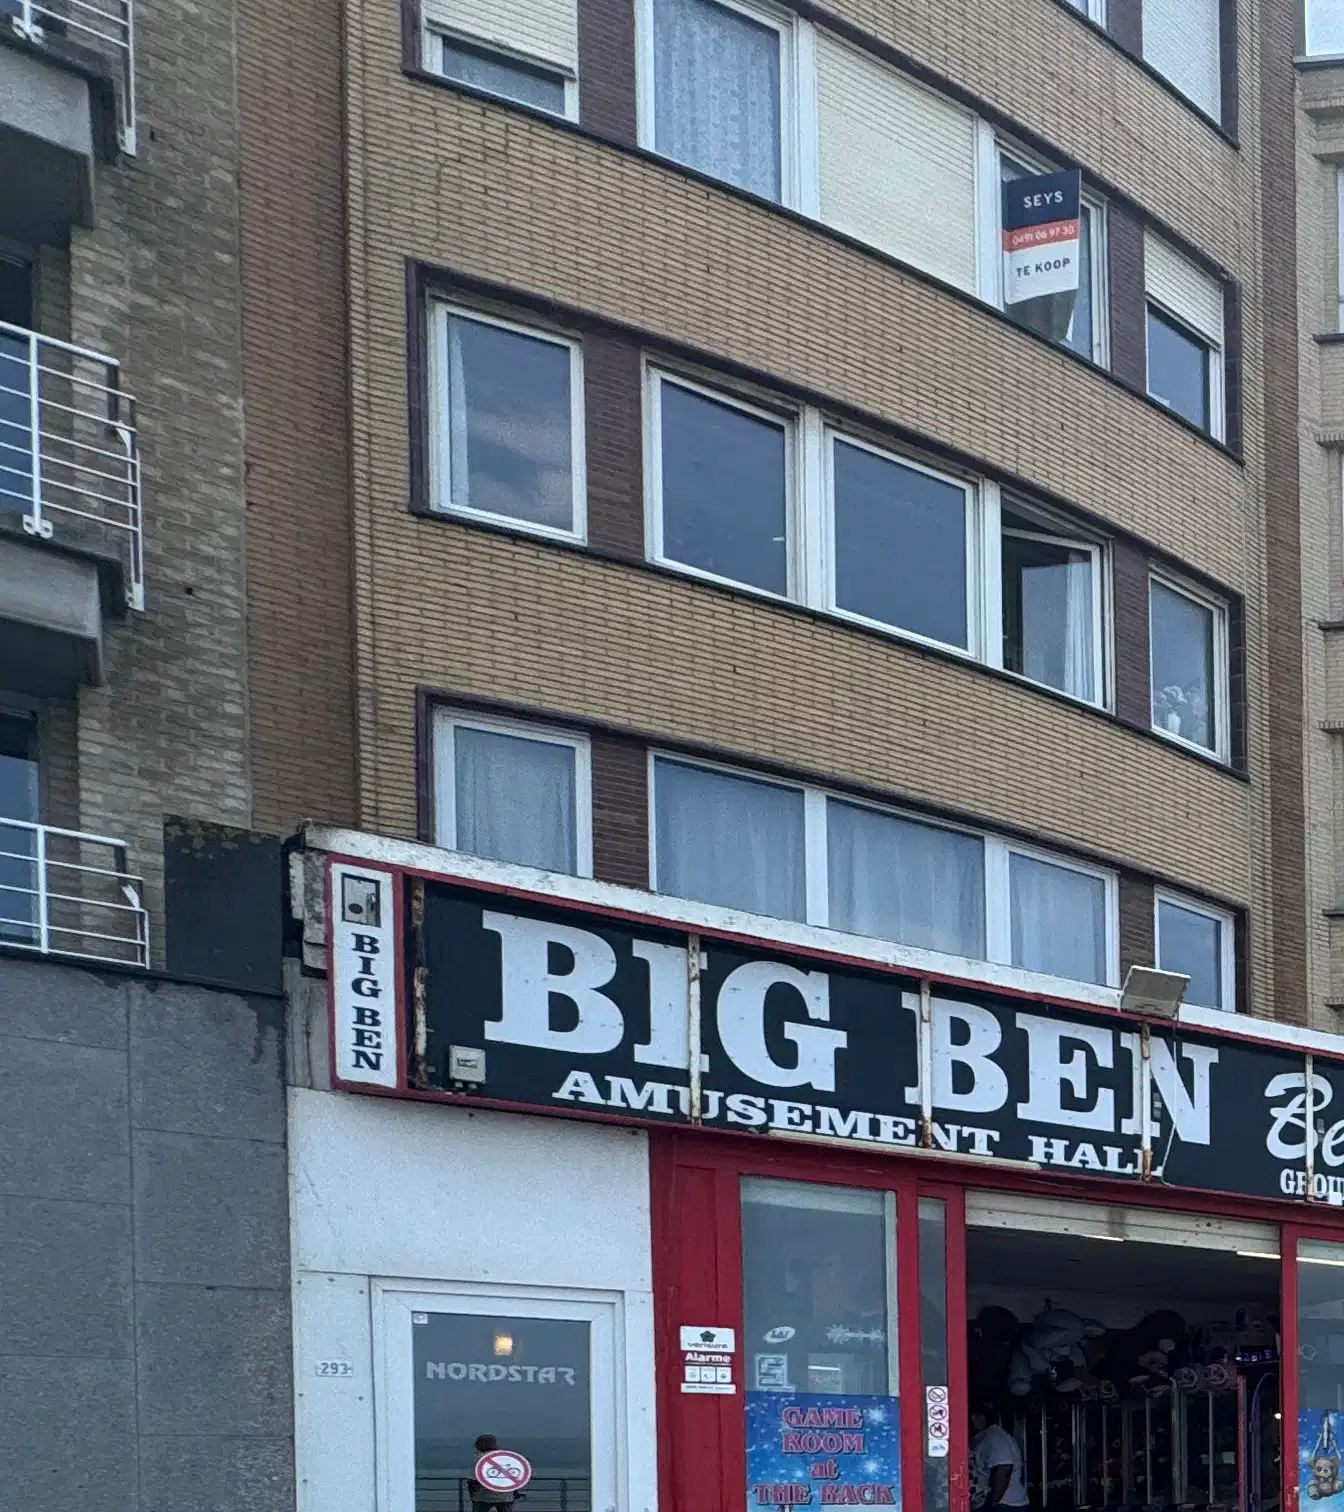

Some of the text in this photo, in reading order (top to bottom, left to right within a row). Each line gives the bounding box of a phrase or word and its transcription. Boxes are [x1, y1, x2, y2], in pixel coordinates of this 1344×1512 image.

[1023, 190, 1063, 208] SEYS
[1016, 257, 1070, 278] TE KOOP
[351, 932, 382, 1072] BIG BEN
[482, 909, 1219, 1147] BIG BEN
[552, 1070, 1163, 1177] AMUSEMENT HALL
[685, 1352, 731, 1363] Alarme
[426, 1361, 576, 1386] NORDSTAR
[781, 1406, 865, 1429] GAME
[782, 1432, 866, 1454] ROOM
[810, 1459, 839, 1480] at
[753, 1483, 896, 1505] THE BACK
